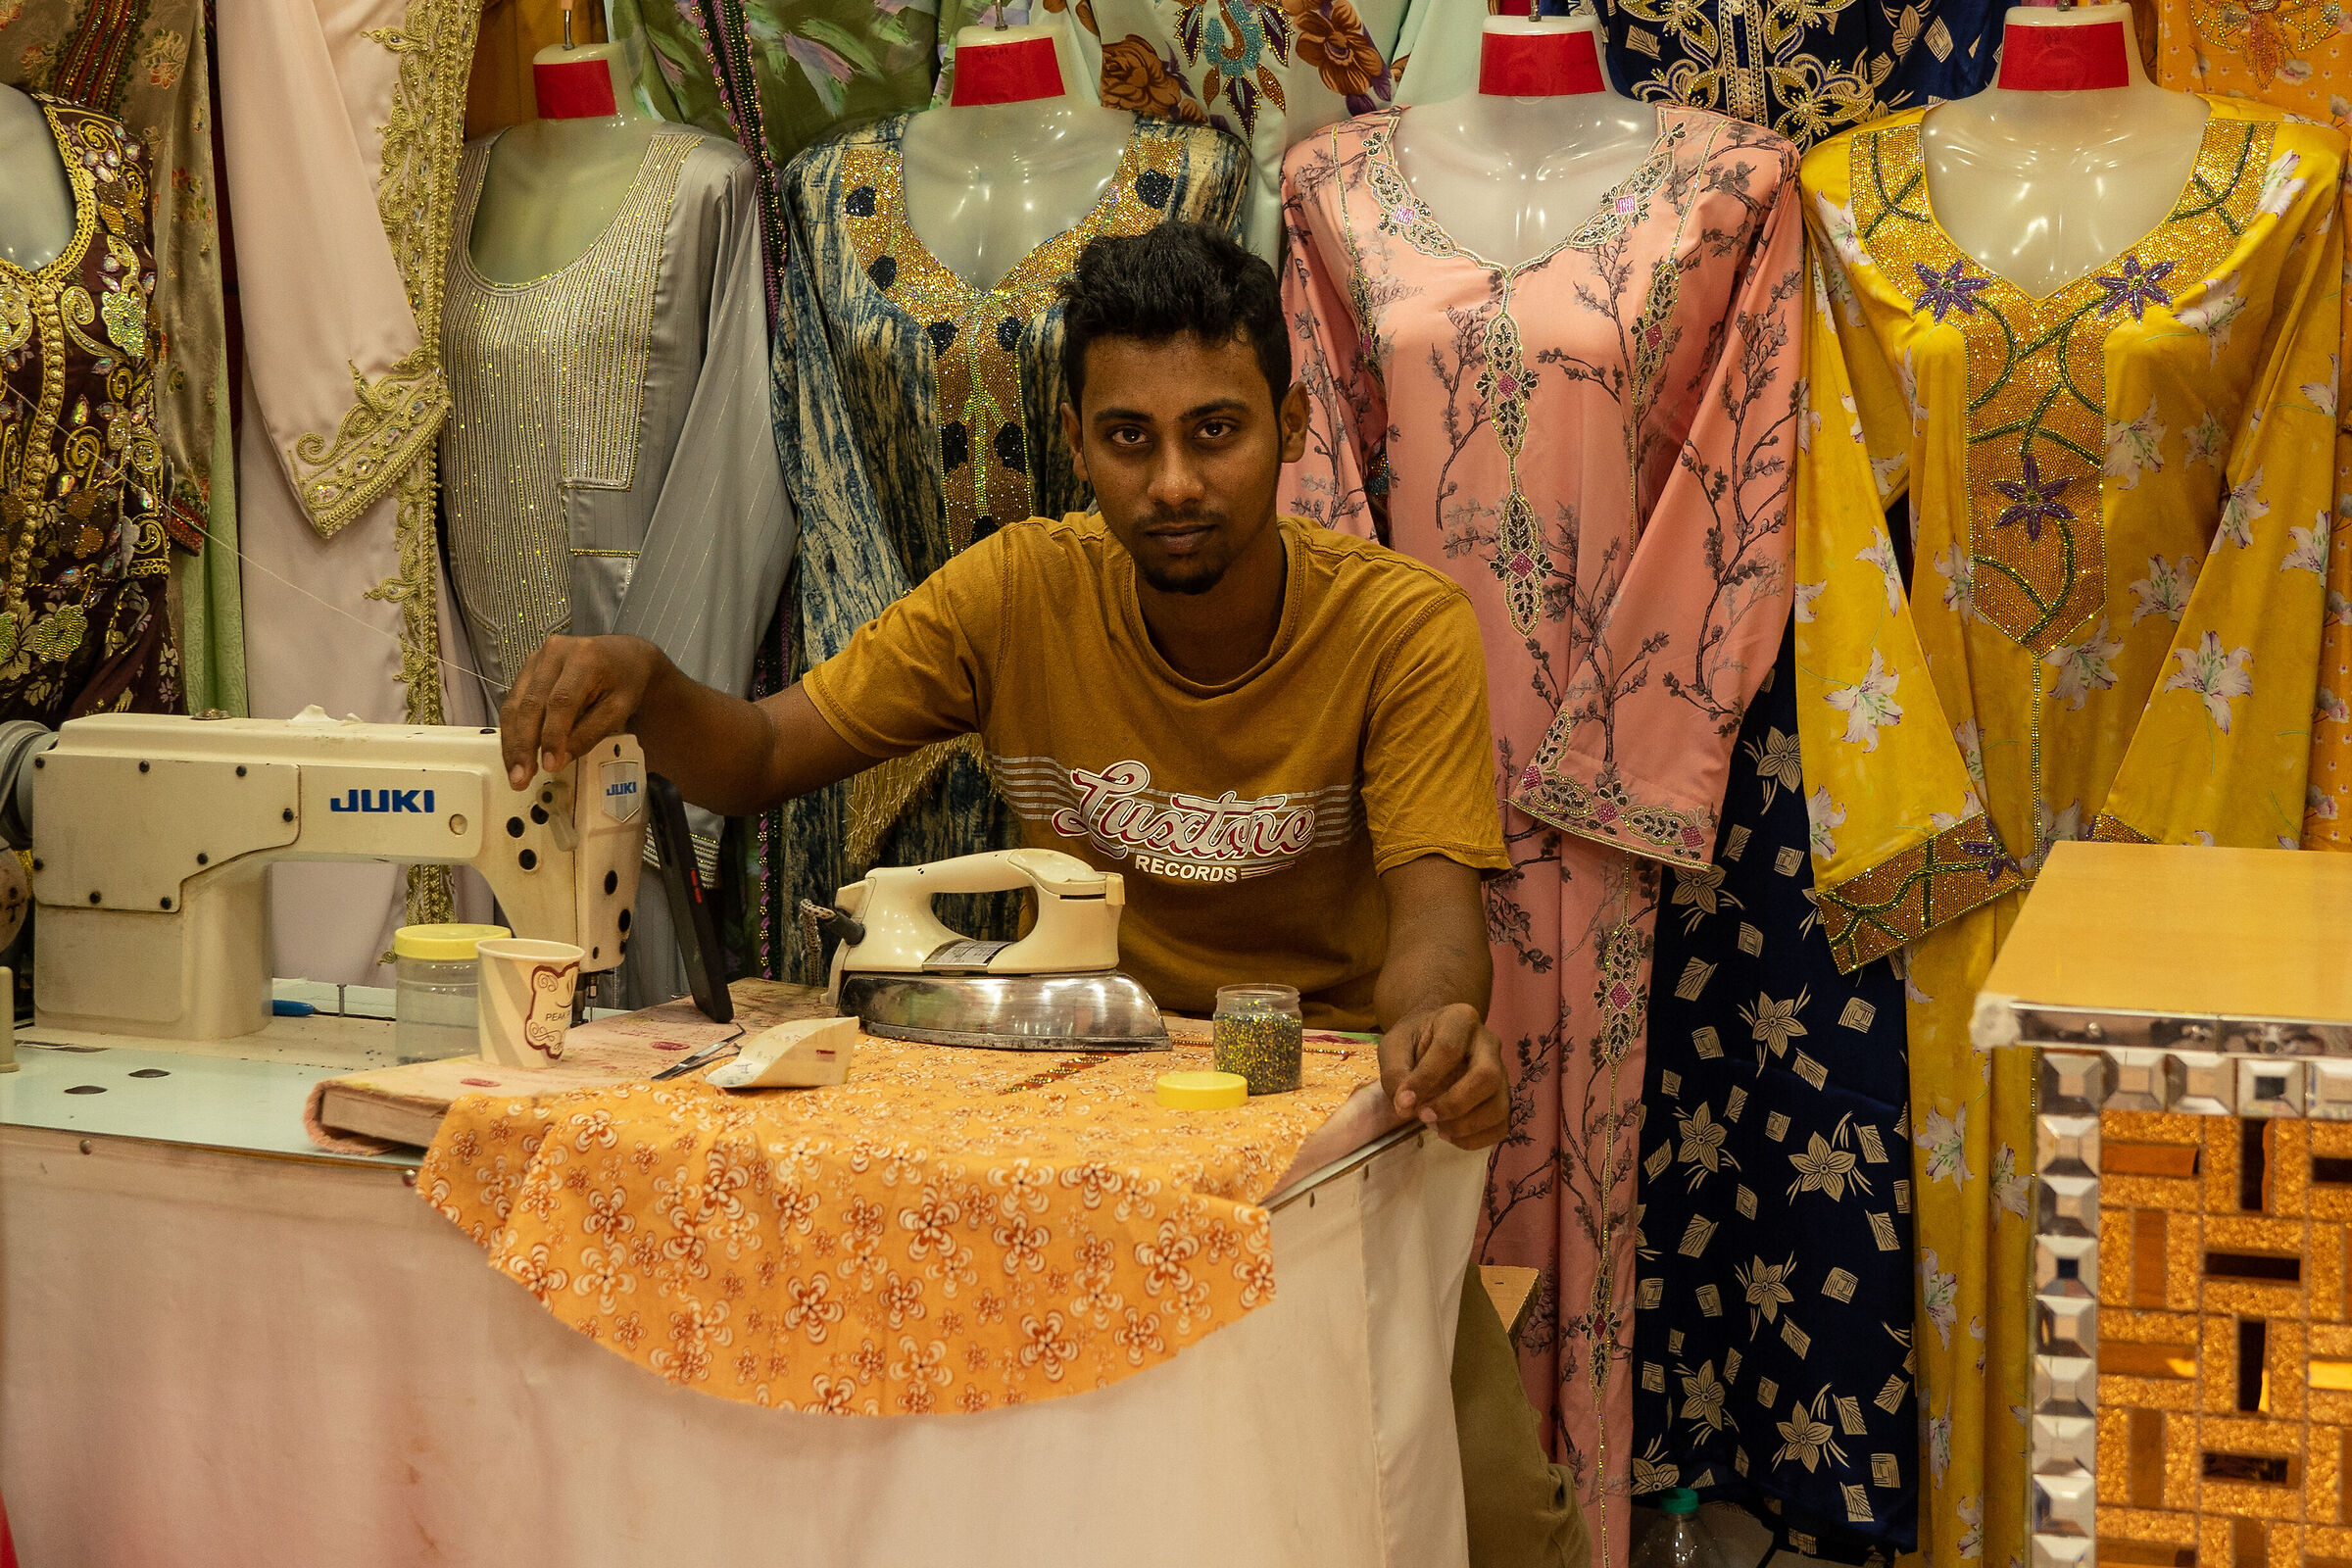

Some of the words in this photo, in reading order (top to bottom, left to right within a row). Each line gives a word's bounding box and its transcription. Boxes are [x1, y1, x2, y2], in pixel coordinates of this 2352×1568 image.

[330, 789, 434, 812] JUKI
[606, 781, 637, 796] JUKI
[1052, 760, 1315, 859] Luxtone
[1135, 855, 1238, 883] RECORDS
